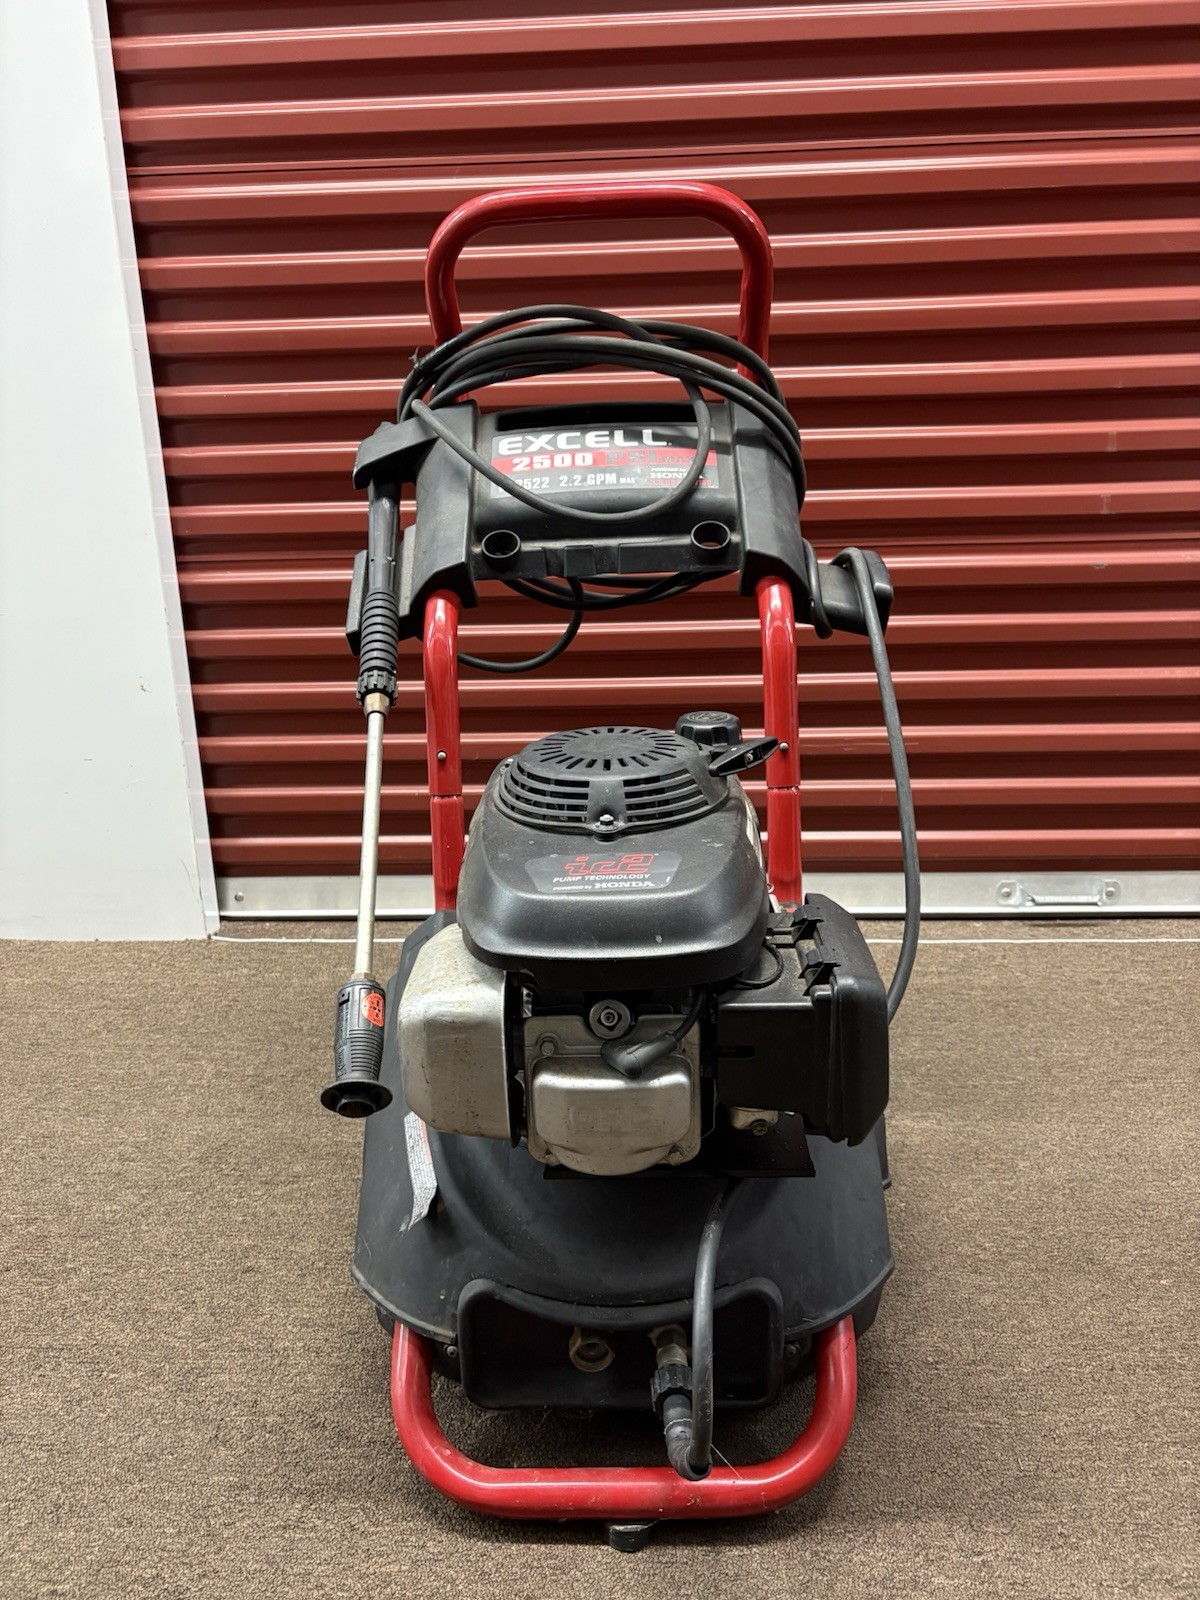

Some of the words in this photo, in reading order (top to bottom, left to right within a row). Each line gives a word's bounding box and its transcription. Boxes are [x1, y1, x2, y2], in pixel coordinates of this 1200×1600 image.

[512, 452, 594, 472] 2500
[605, 449, 659, 466] PSI
[559, 474, 583, 488] 2.2
[586, 472, 618, 486] GPM
[584, 873, 652, 882] TECHNOLOGY
[593, 881, 656, 889] HONDA
